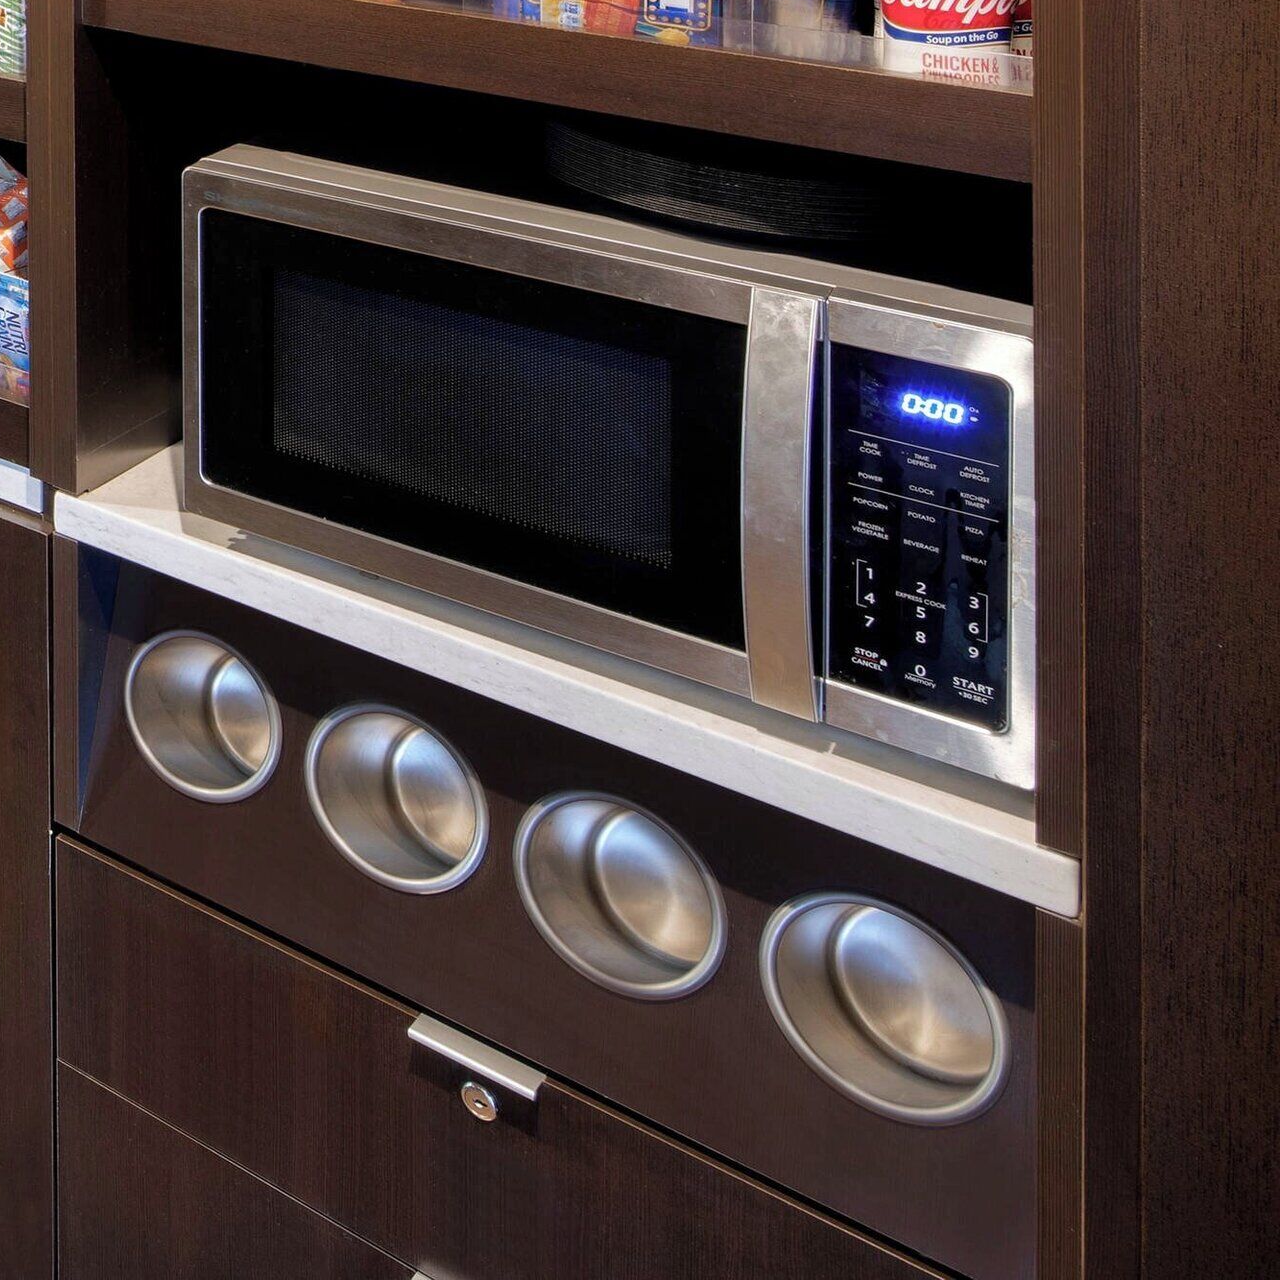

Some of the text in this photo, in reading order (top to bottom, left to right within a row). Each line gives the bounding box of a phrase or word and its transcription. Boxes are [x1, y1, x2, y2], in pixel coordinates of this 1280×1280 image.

[926, 31, 999, 46] Soup on the Go
[922, 52, 1000, 74] CHICKEN &
[6, 309, 28, 355] NUTRI
[862, 440, 879, 450] TIME
[859, 447, 882, 457] COOK
[913, 453, 930, 462] TIME
[907, 458, 938, 470] DEFROST
[963, 466, 984, 475] AUTO
[857, 471, 884, 483] POWER
[959, 471, 991, 484] DEFROST
[908, 484, 935, 497] CLOCK
[852, 496, 888, 511] POPCORN
[959, 491, 990, 505] KITCHEN
[964, 500, 986, 510] TIMER
[907, 511, 936, 523] POTATO
[857, 520, 886, 532] FROZEN
[964, 526, 985, 536] PIZZA
[851, 525, 889, 541] VEGETABLE
[903, 538, 940, 554] BEVERAGE
[960, 553, 988, 567] REHEAT
[865, 567, 873, 580] 1
[915, 581, 927, 595] 2
[863, 592, 876, 604] 4
[895, 590, 947, 610] EXPRESS COOK
[968, 596, 980, 609] 3
[916, 606, 926, 619] 5
[864, 615, 876, 627] 7
[968, 622, 980, 635] 6
[915, 631, 927, 644] 8
[854, 646, 879, 659] STOP
[968, 646, 980, 659] 9
[851, 656, 883, 671] CANCEL
[914, 664, 926, 677] 0
[904, 673, 937, 689] Memory
[952, 676, 995, 696] START
[973, 695, 988, 705] SEC
